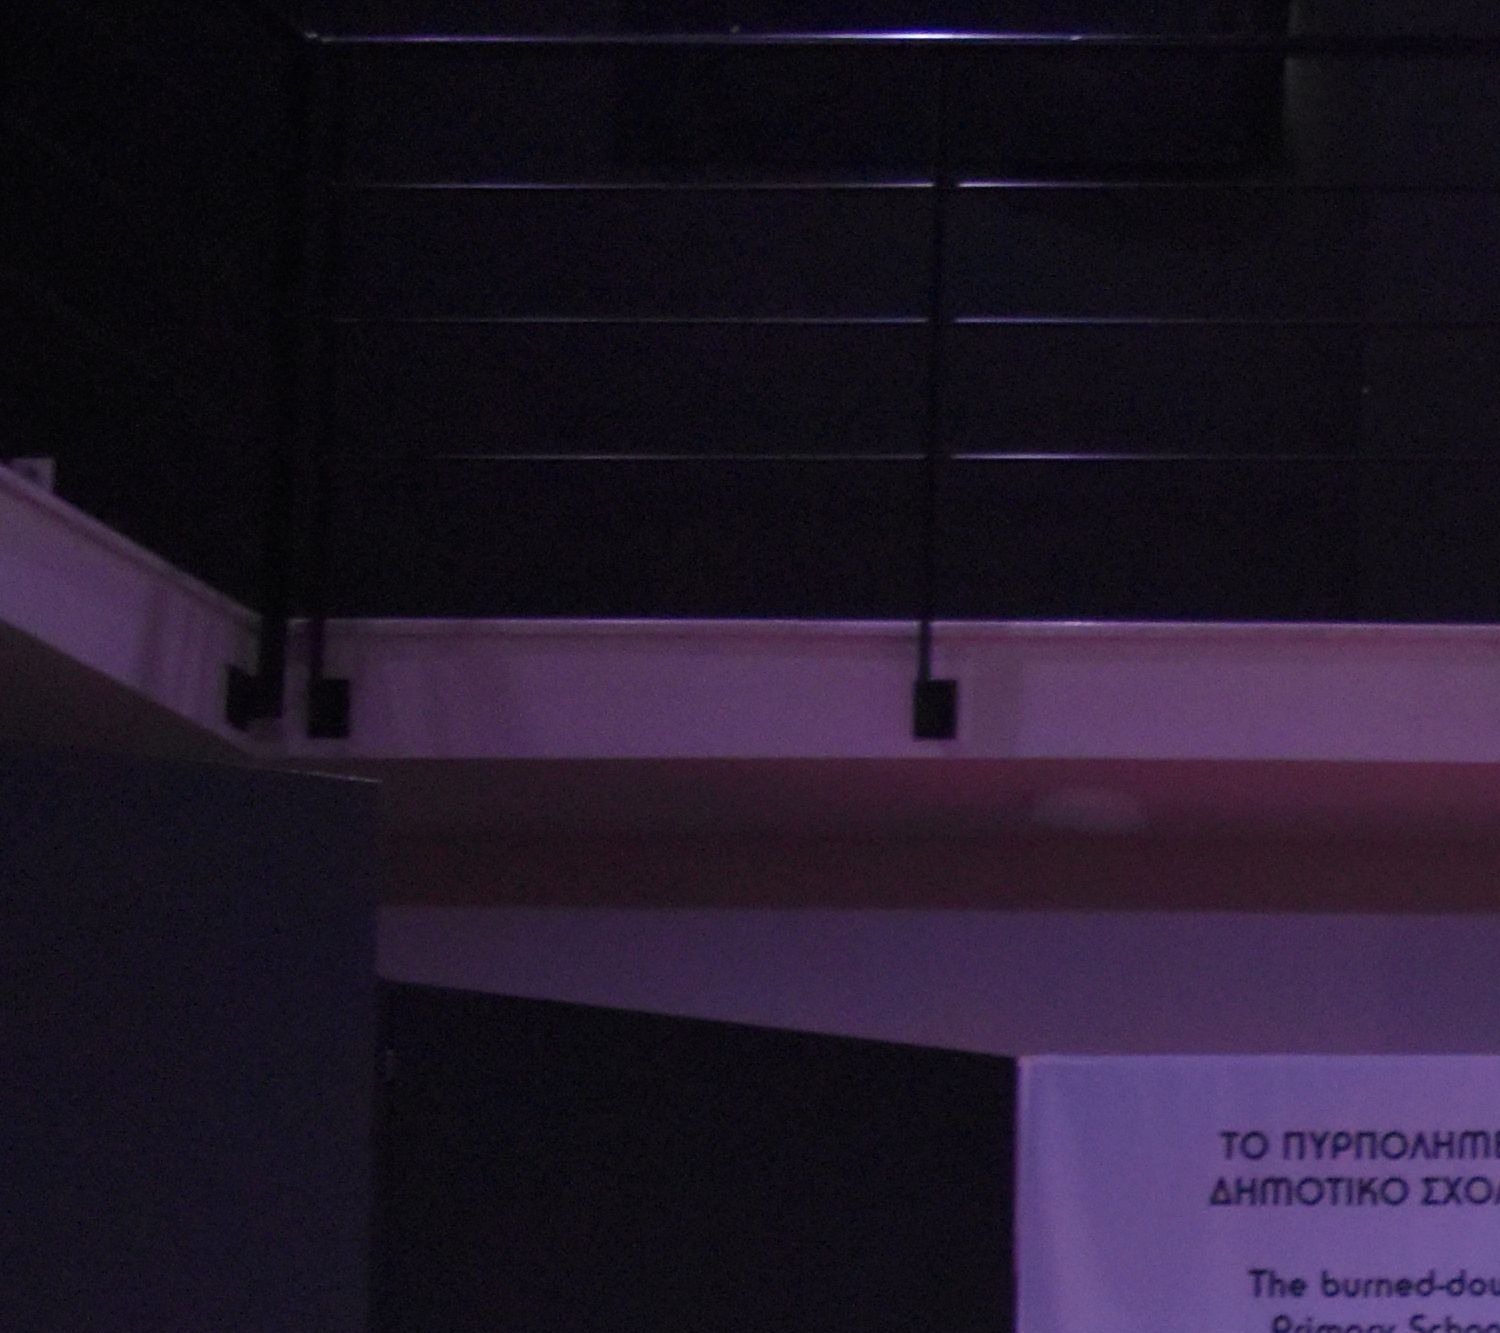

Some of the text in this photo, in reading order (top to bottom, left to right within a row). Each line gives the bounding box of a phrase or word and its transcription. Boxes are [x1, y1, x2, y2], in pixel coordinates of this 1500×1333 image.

[1219, 1130, 1270, 1161] ΤΟ
[1209, 1176, 1409, 1207] ΔΗΜΟΤΙΚΟ
[1247, 1267, 1308, 1298] The
